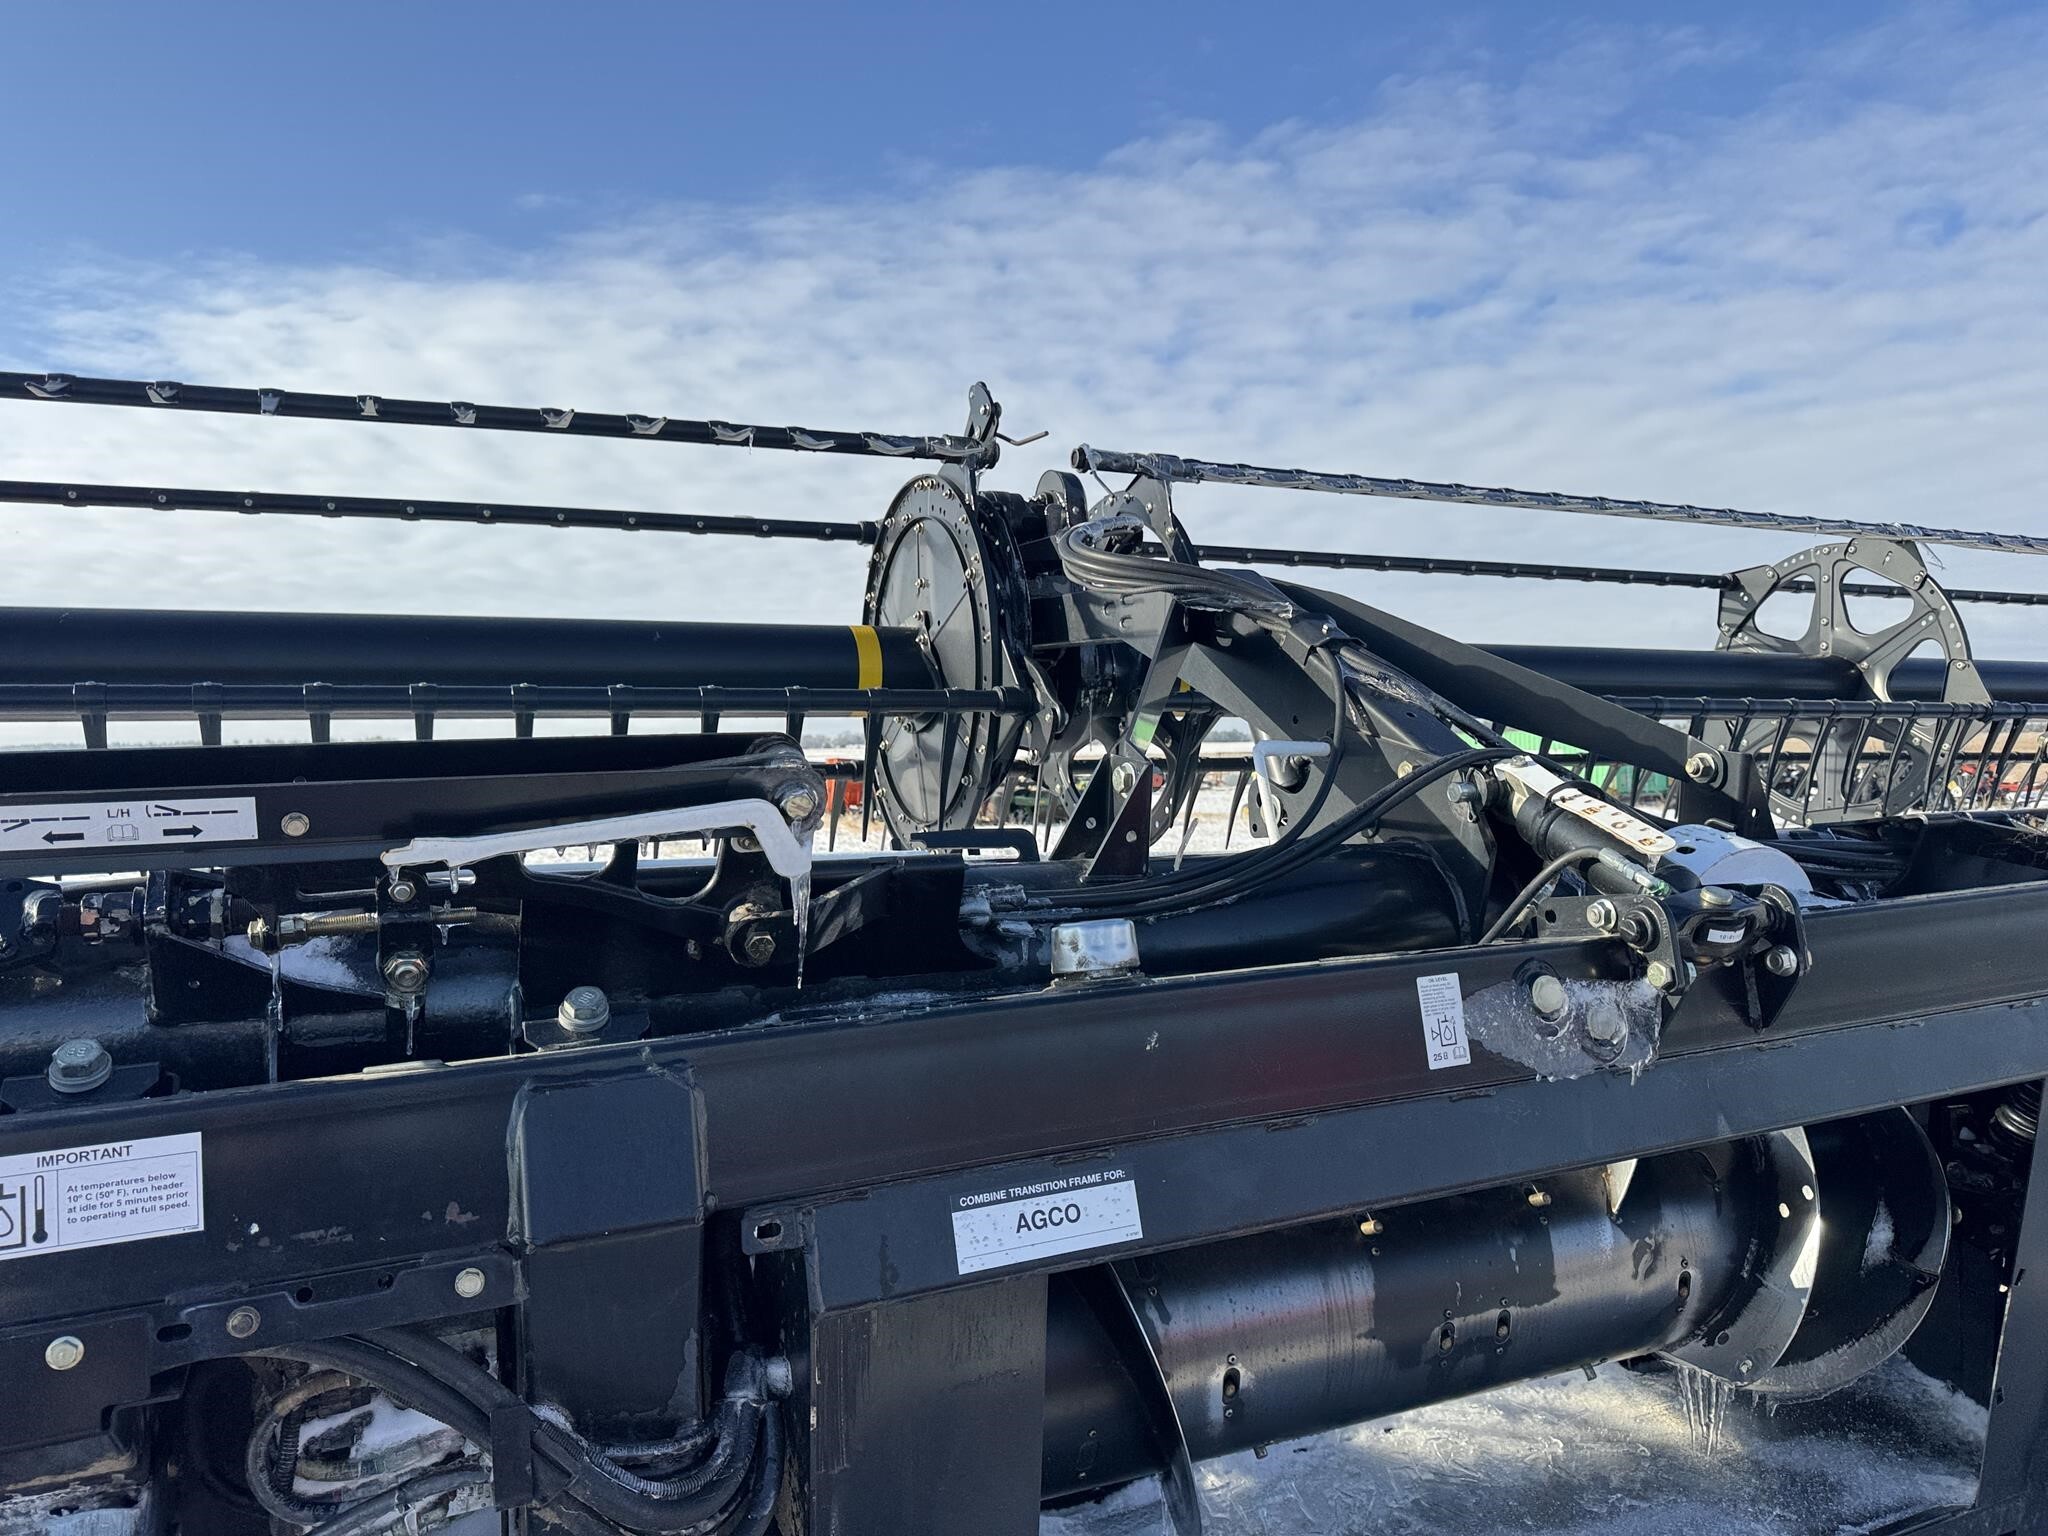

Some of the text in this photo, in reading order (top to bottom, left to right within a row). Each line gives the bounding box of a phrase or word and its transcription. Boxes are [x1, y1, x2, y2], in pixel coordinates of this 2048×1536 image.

[107, 808, 130, 818] L/H
[37, 1145, 133, 1168] IMPORTANT
[67, 1171, 177, 1193] At temperatures below
[85, 1193, 93, 1201] C
[117, 1188, 130, 1199] F),
[132, 1186, 148, 1195] run
[151, 1181, 184, 1192] header
[960, 1169, 1126, 1207] COMBINE TRANSITION FRAME FOR:
[67, 1190, 189, 1214] at idle for 5 minutes prior
[67, 1200, 190, 1225] to operating at full speed.
[1015, 1203, 1082, 1234] AGCO
